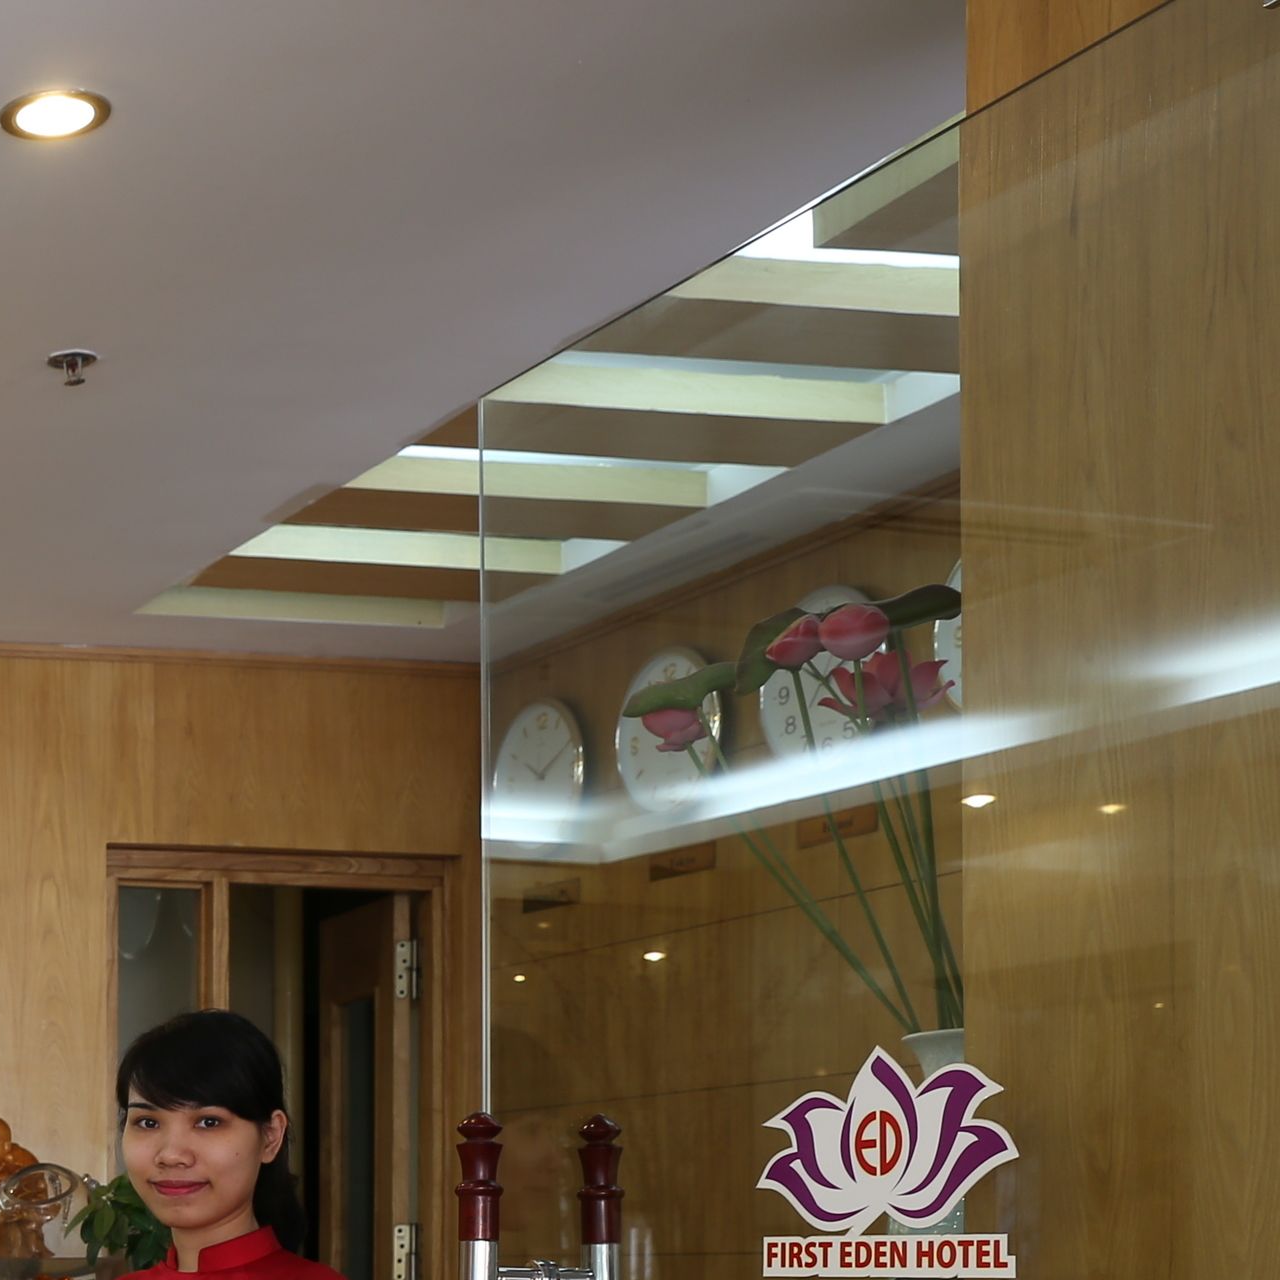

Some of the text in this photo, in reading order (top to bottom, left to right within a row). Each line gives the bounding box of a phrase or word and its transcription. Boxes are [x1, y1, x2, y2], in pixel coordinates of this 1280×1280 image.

[779, 686, 790, 705] 9
[785, 715, 797, 735] 8
[842, 720, 855, 740] 5
[854, 1109, 903, 1176] ED
[766, 1239, 1008, 1269] FIRST EDEN HOTEL
